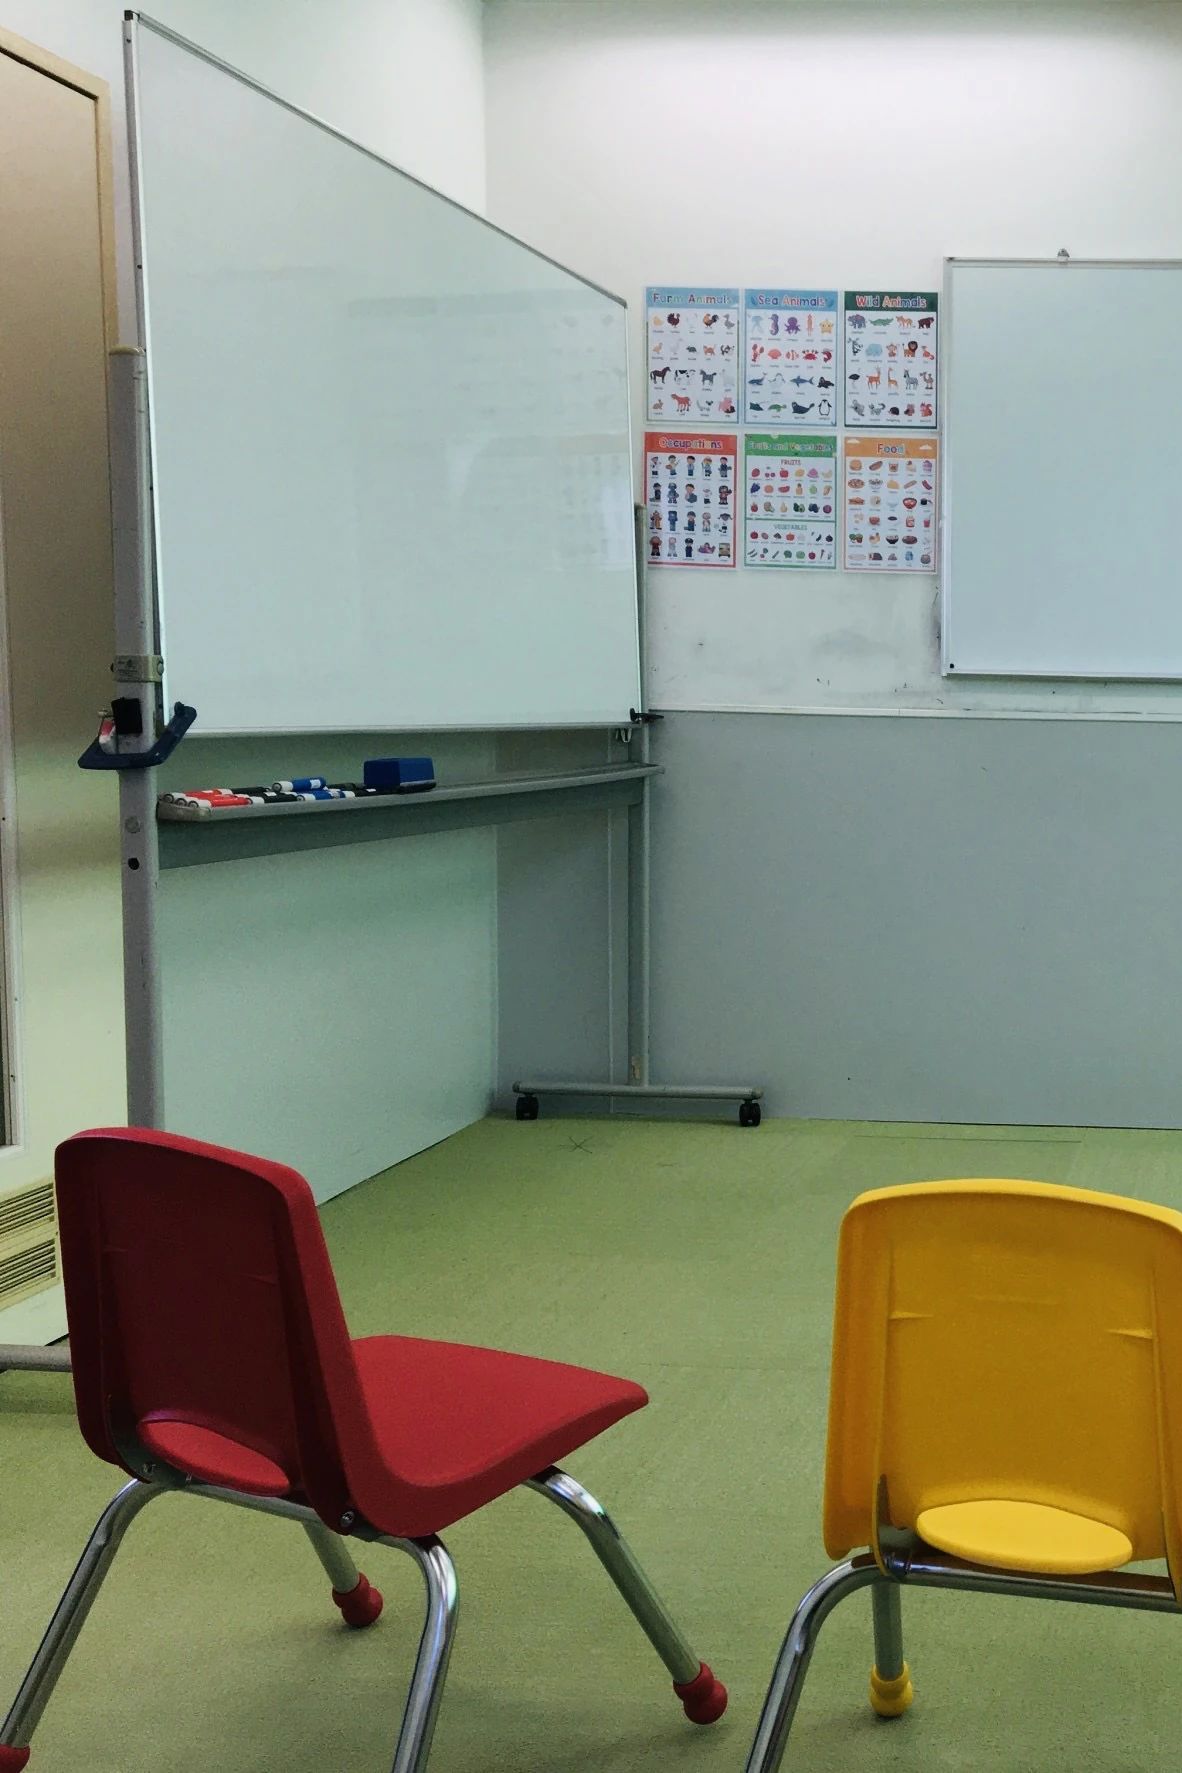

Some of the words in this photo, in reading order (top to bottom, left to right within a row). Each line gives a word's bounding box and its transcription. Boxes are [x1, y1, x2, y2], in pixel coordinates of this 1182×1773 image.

[653, 293, 682, 303] Farm
[688, 294, 732, 304] Animals
[758, 294, 778, 305] Sea
[782, 295, 825, 306] Animals
[855, 295, 880, 307] Wild
[882, 296, 927, 308] Animals
[658, 437, 723, 450] Occupations
[877, 443, 905, 454] Food
[773, 523, 808, 531] VEGETABLES
